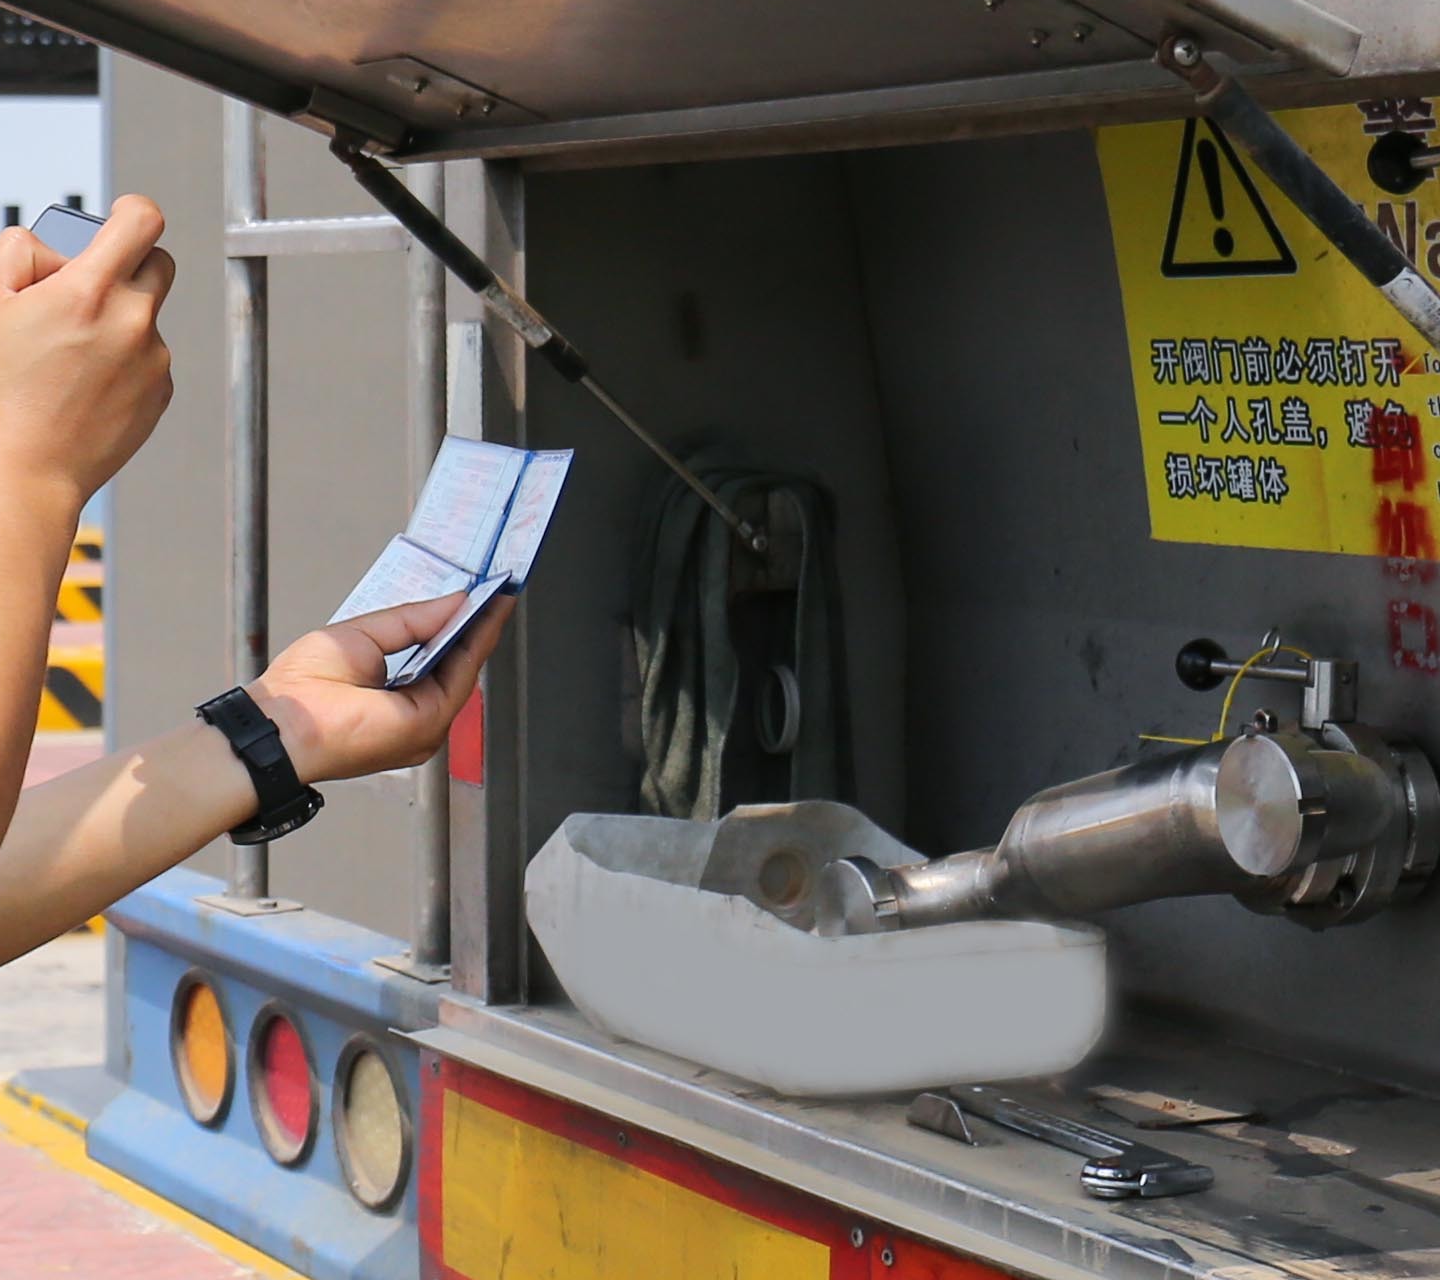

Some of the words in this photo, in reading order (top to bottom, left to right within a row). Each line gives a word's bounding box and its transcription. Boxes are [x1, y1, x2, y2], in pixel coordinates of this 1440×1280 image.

[1151, 336, 1403, 387] 开阀门前必须打开
[1166, 452, 1289, 503] 损坏罐体
